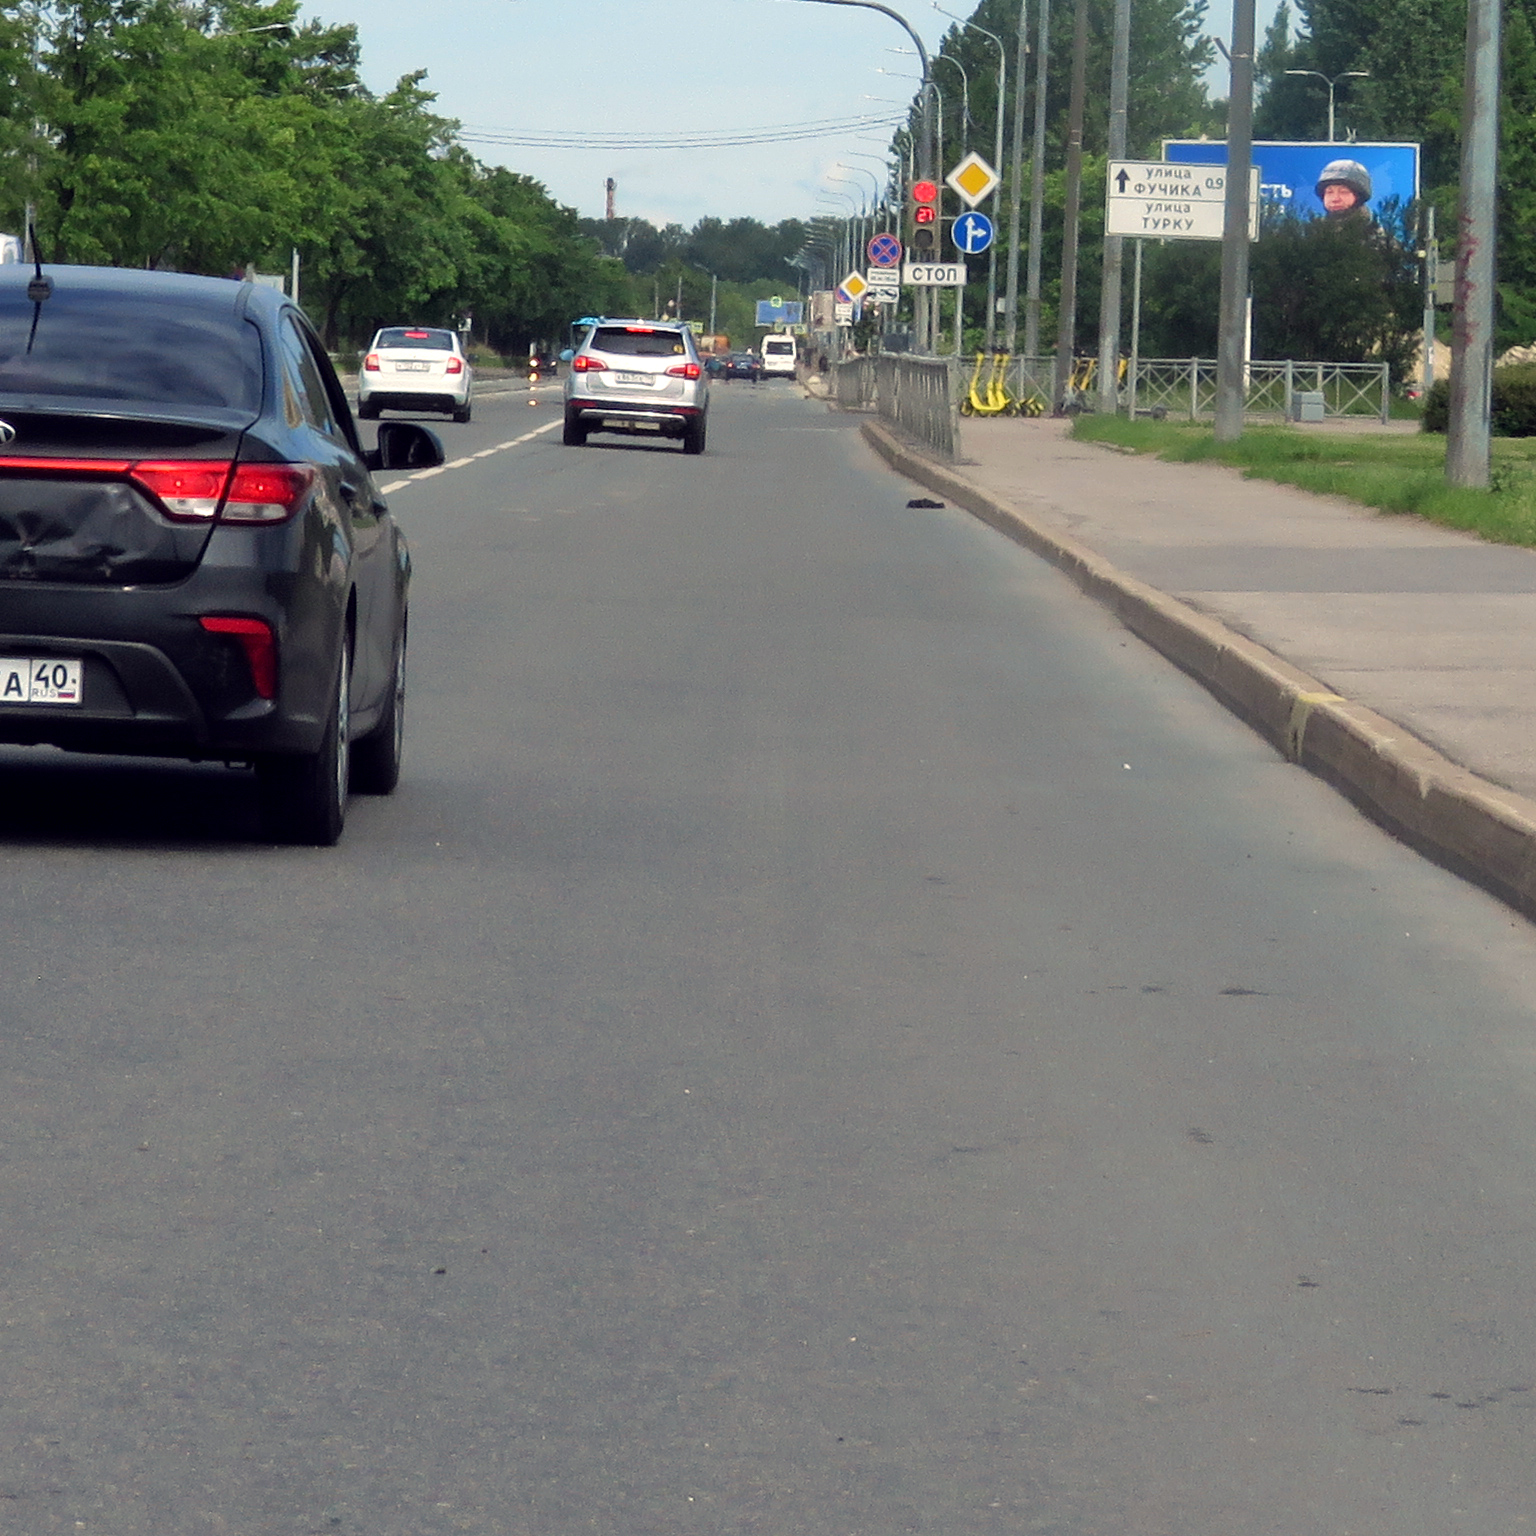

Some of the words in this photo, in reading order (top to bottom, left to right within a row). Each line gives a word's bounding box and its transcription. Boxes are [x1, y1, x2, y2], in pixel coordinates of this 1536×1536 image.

[1146, 167, 1192, 181] улица
[1134, 182, 1202, 197] ФУЧИКА
[1145, 202, 1192, 215] улица
[1142, 216, 1195, 232] ТУРКУ
[912, 267, 957, 281] СТОП
